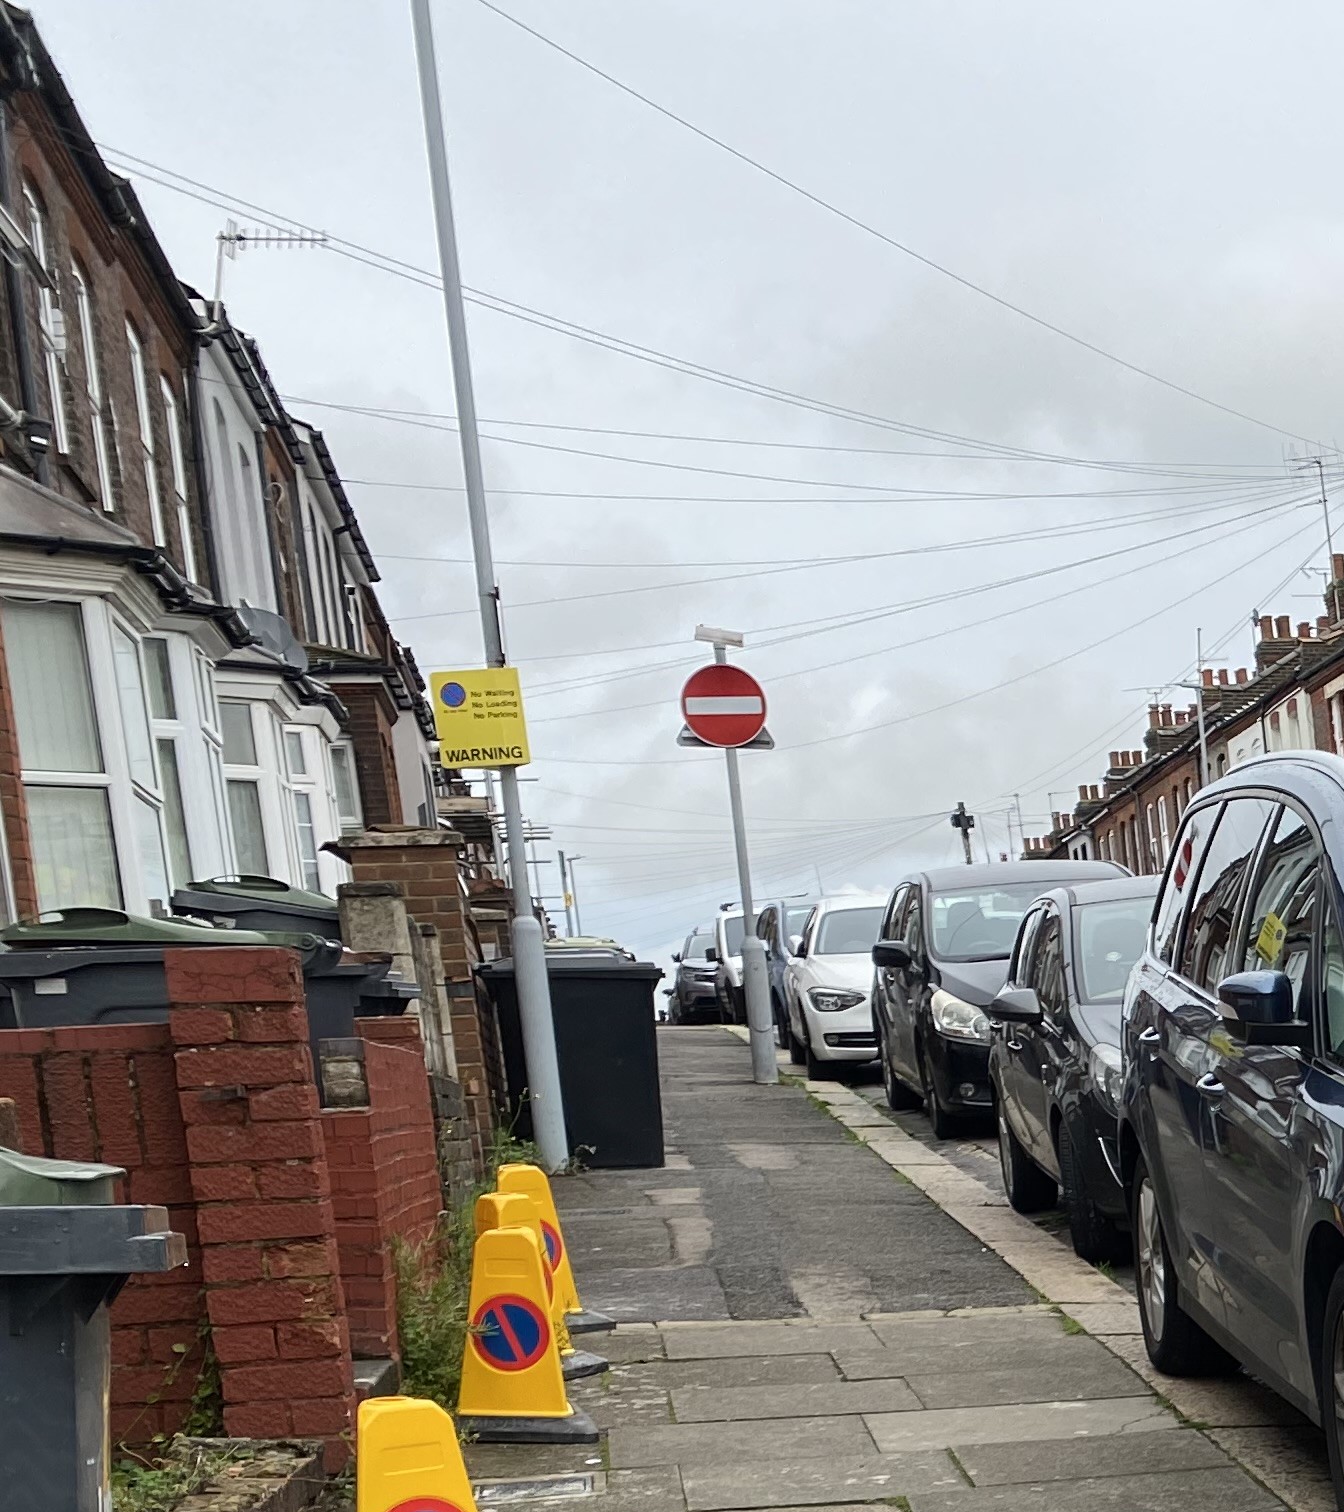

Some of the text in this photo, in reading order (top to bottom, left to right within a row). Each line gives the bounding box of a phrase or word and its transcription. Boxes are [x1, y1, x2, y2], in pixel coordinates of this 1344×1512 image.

[486, 700, 518, 708] Loading
[487, 711, 518, 719] Parking
[445, 745, 522, 763] WARNING
